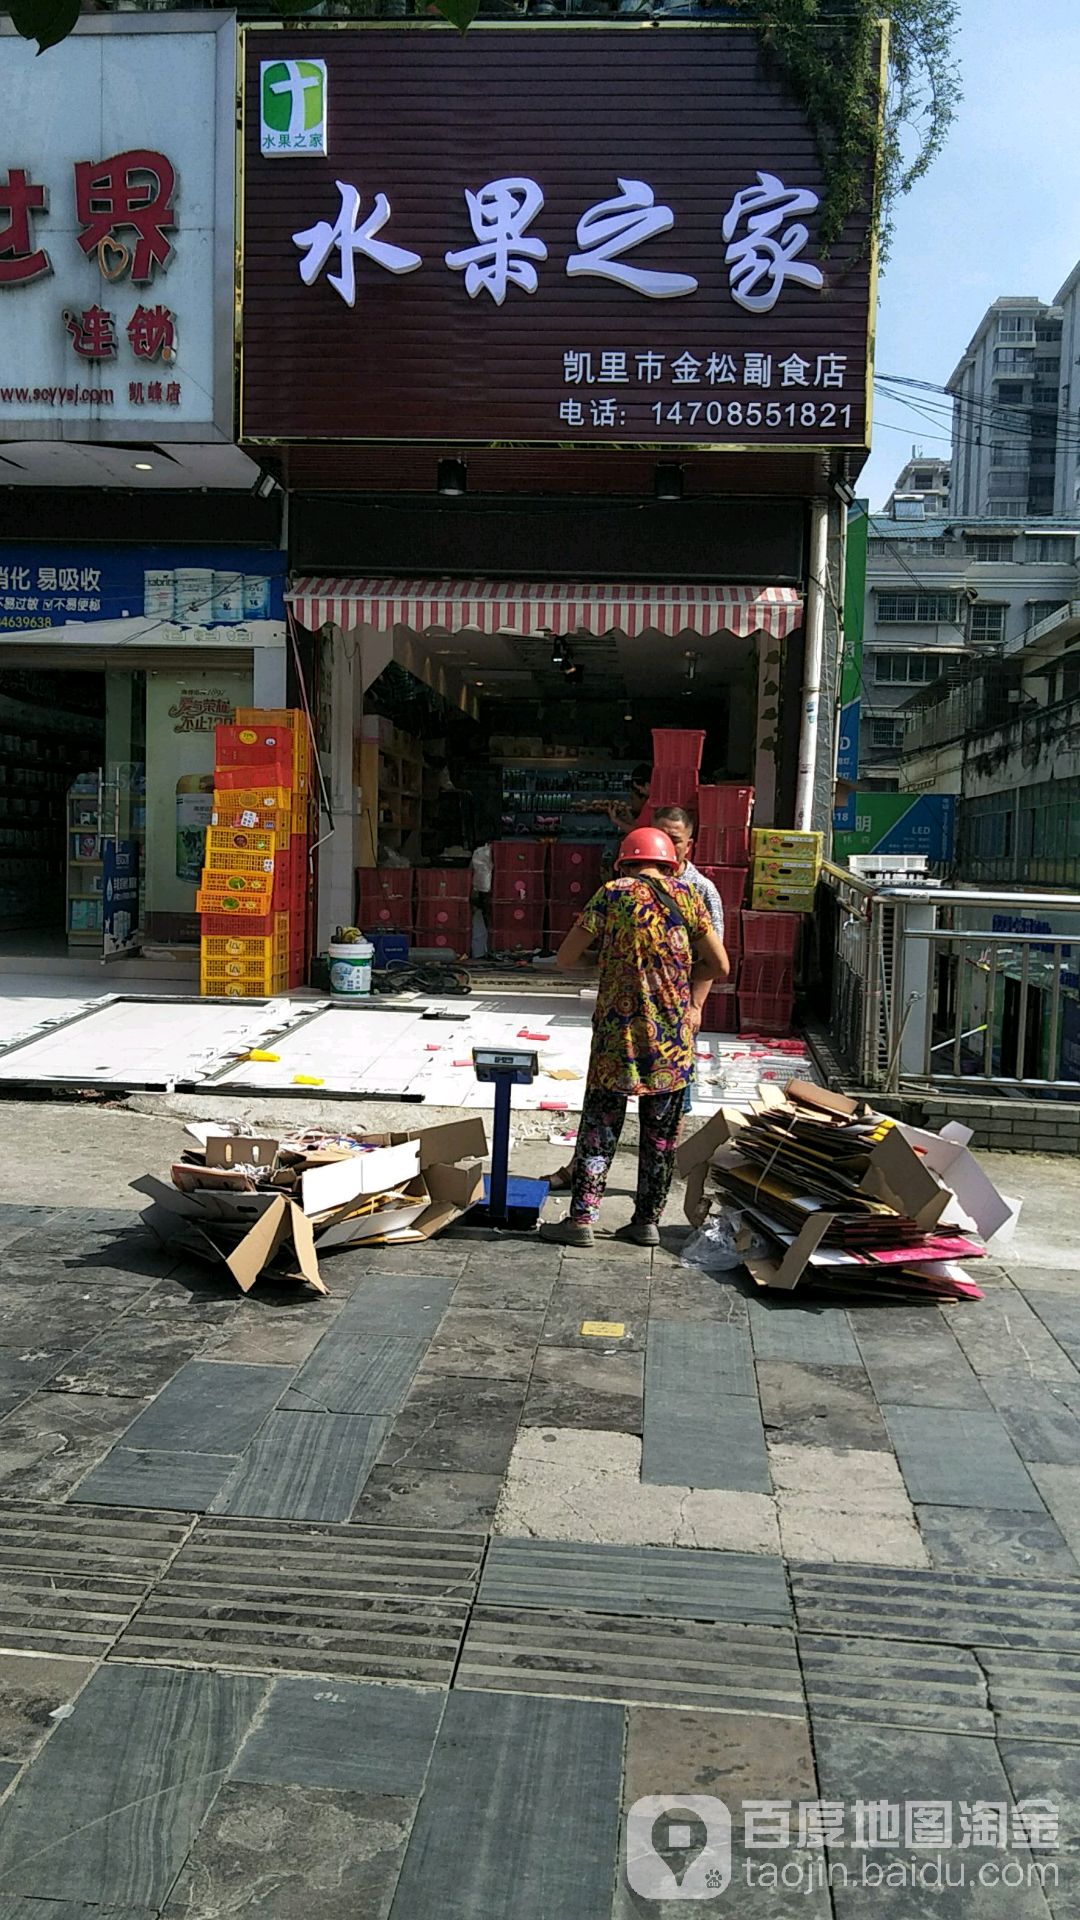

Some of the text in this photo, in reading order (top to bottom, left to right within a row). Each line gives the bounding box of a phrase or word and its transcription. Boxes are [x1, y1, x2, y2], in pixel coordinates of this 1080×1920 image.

[262, 133, 323, 149] 水果之家
[292, 171, 824, 313] 水果之家
[65, 304, 176, 361] 连锁
[563, 351, 847, 388] 凯里市金松副食店
[651, 401, 851, 428] 14708551821
[37, 567, 101, 592] 易吸收
[912, 826, 931, 835] LED
